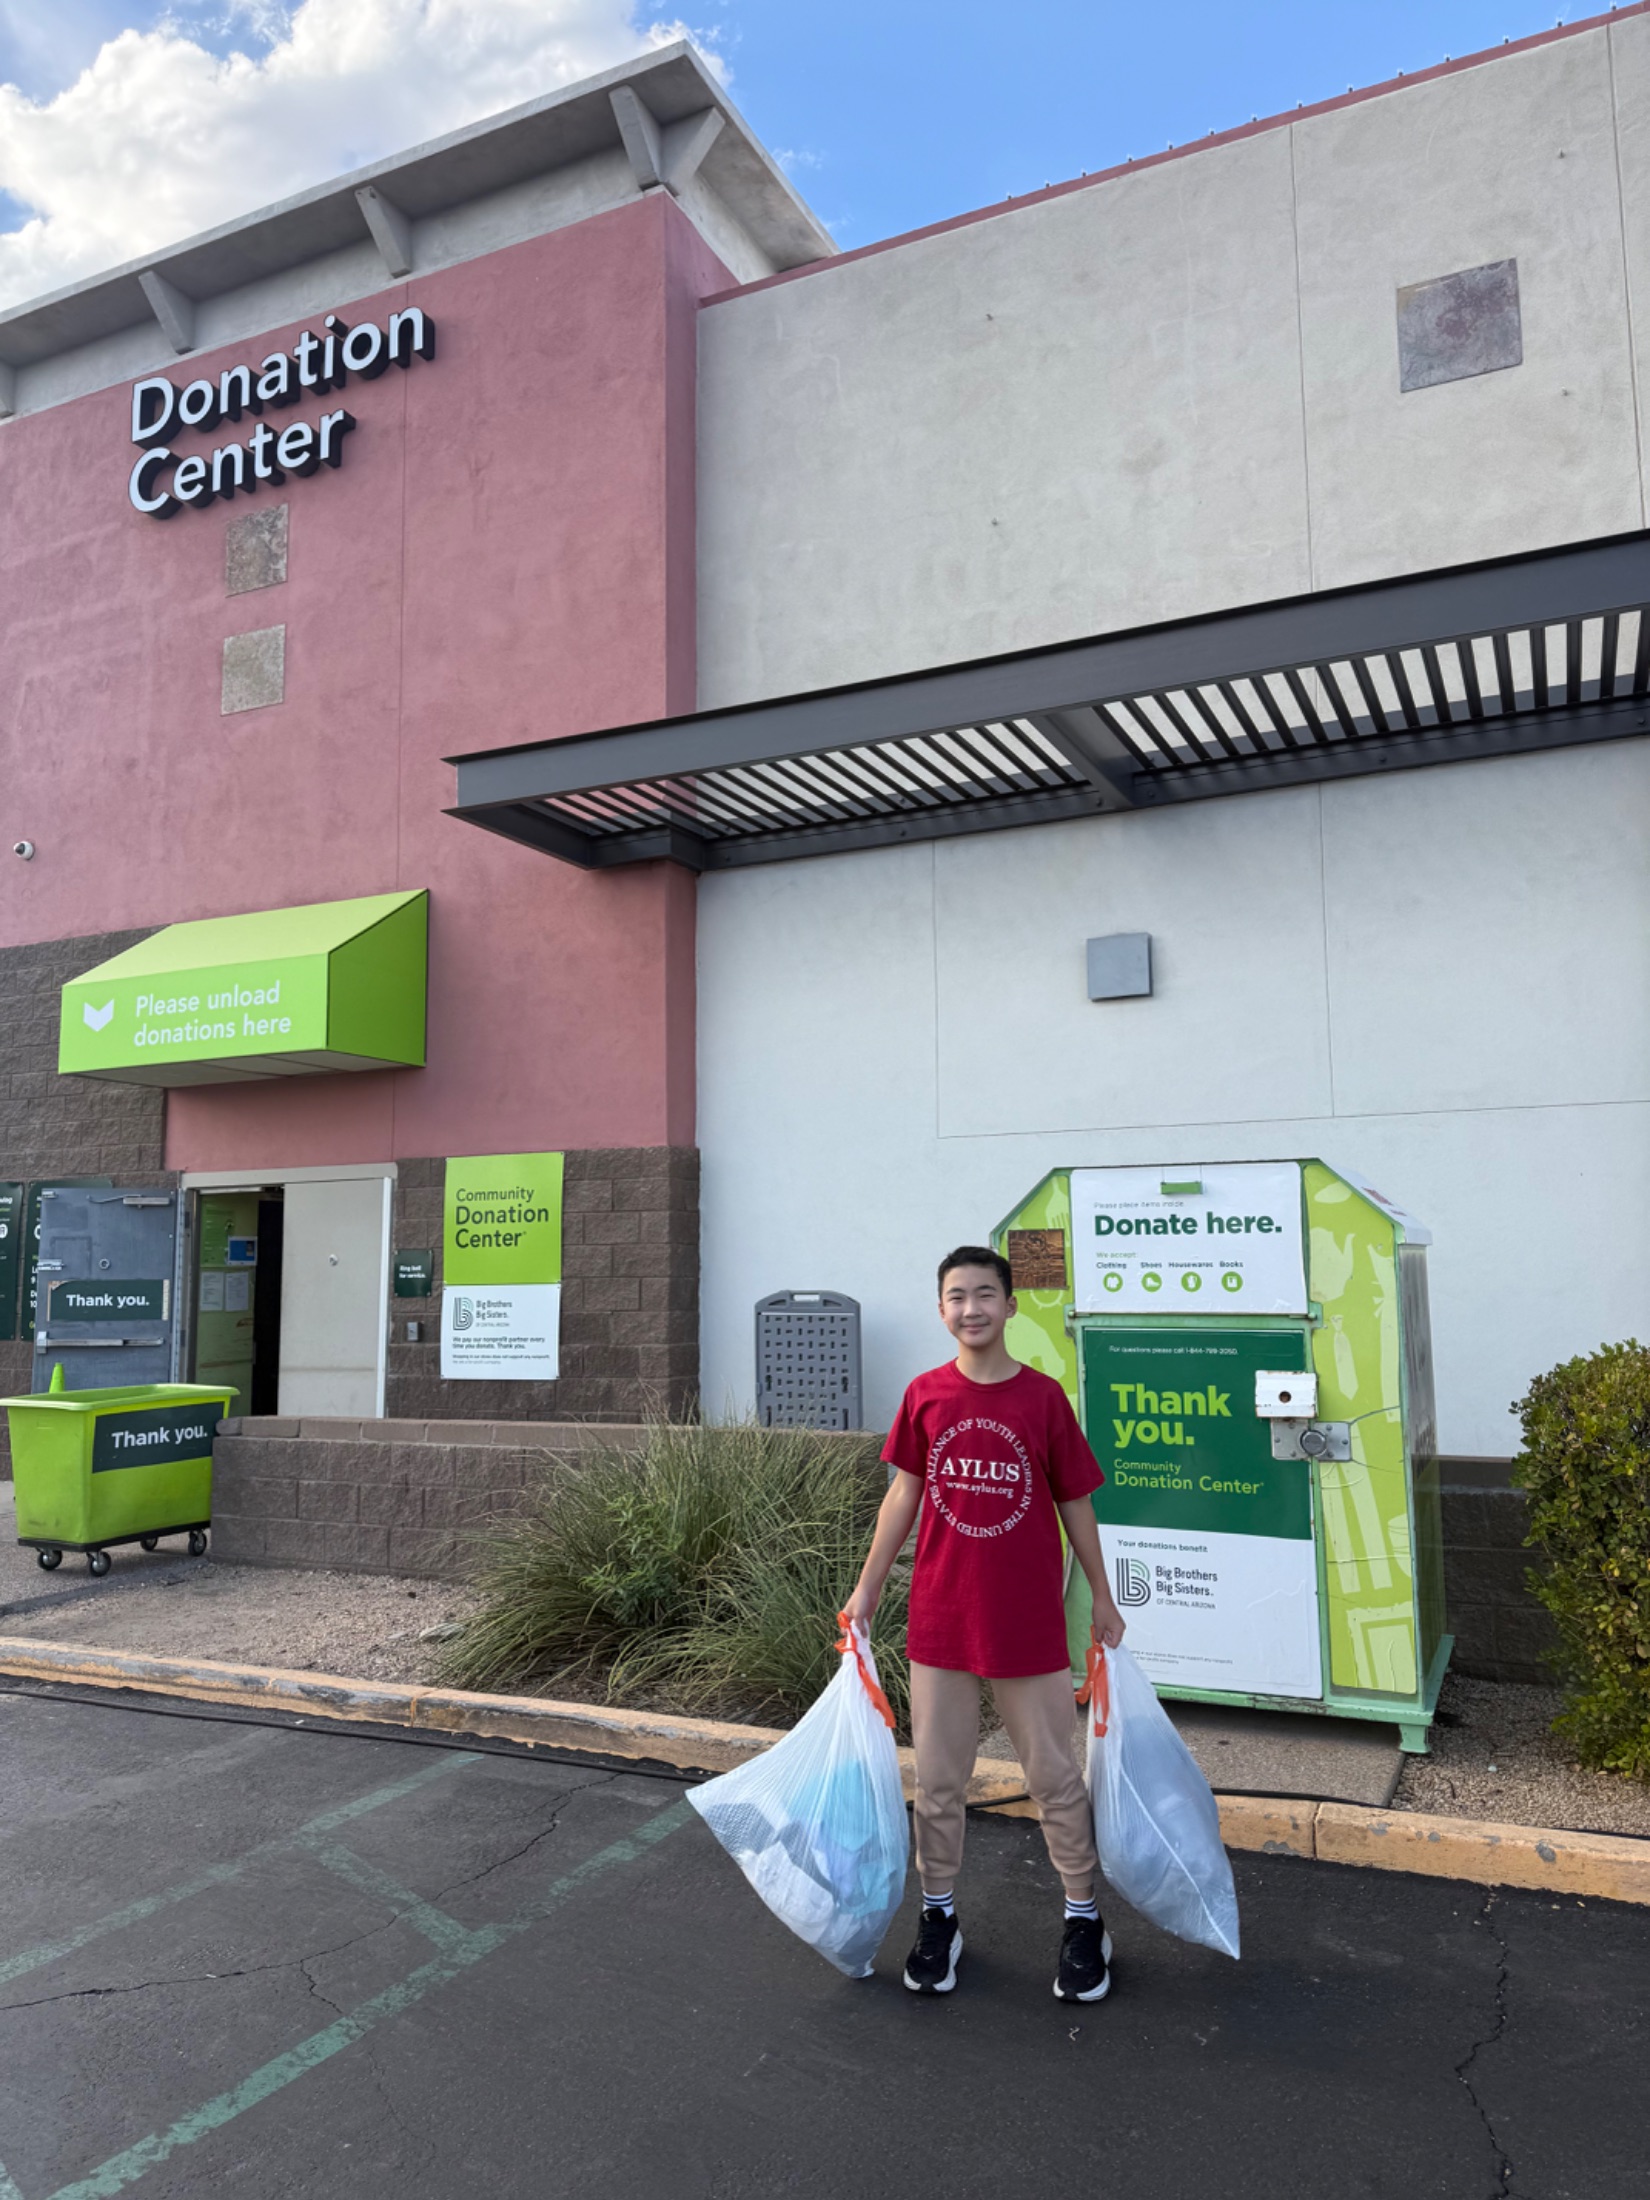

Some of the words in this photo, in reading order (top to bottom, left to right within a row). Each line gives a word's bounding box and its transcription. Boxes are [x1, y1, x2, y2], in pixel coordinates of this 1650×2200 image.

[131, 307, 428, 445] Donation
[128, 409, 348, 514] Center
[135, 993, 200, 1018] Please
[207, 980, 281, 1010] unload
[133, 1018, 236, 1047] donations
[242, 1013, 292, 1037] here
[455, 1186, 535, 1203] Community
[455, 1204, 549, 1226] Donation
[1094, 1213, 1199, 1237] Donate
[1206, 1211, 1283, 1234] here.
[455, 1228, 523, 1249] Center
[1096, 1261, 1127, 1270] Clothing
[1140, 1261, 1163, 1269] Shoes
[1168, 1260, 1214, 1269] Housewares
[1219, 1259, 1244, 1268] Books
[66, 1293, 113, 1307] Thank
[117, 1295, 150, 1309] you.
[476, 1300, 486, 1310] Big
[487, 1299, 513, 1308] Brothers
[476, 1310, 486, 1320] Big
[1108, 1344, 1120, 1353] For
[1121, 1345, 1151, 1354] questions
[1152, 1346, 1172, 1355] please
[1173, 1346, 1184, 1354] call
[1110, 1382, 1232, 1417] Thank
[957, 1418, 974, 1432] OF
[975, 1417, 1016, 1443] YOUTH
[1112, 1418, 1195, 1449] you.
[111, 1426, 170, 1449] Thank
[174, 1425, 208, 1445] you.
[927, 1426, 958, 1483] ALLIANCE
[940, 1456, 1020, 1482] AYLUS
[1012, 1440, 1033, 1493] LEADERS
[1113, 1458, 1181, 1475] Community
[945, 1481, 1014, 1499] www.aylus.org
[1114, 1471, 1193, 1490] Donation
[1198, 1475, 1260, 1495] Center
[929, 1485, 958, 1527] STATES
[1020, 1494, 1032, 1511] IN
[956, 1522, 1003, 1538] UNITED
[1002, 1510, 1025, 1532] THE
[1117, 1539, 1136, 1548] Your
[1137, 1540, 1177, 1551] donations
[1156, 1565, 1173, 1580] Big
[1174, 1567, 1218, 1582] Brothers
[1156, 1581, 1173, 1596] Big
[1175, 1582, 1214, 1597] Sisters.
